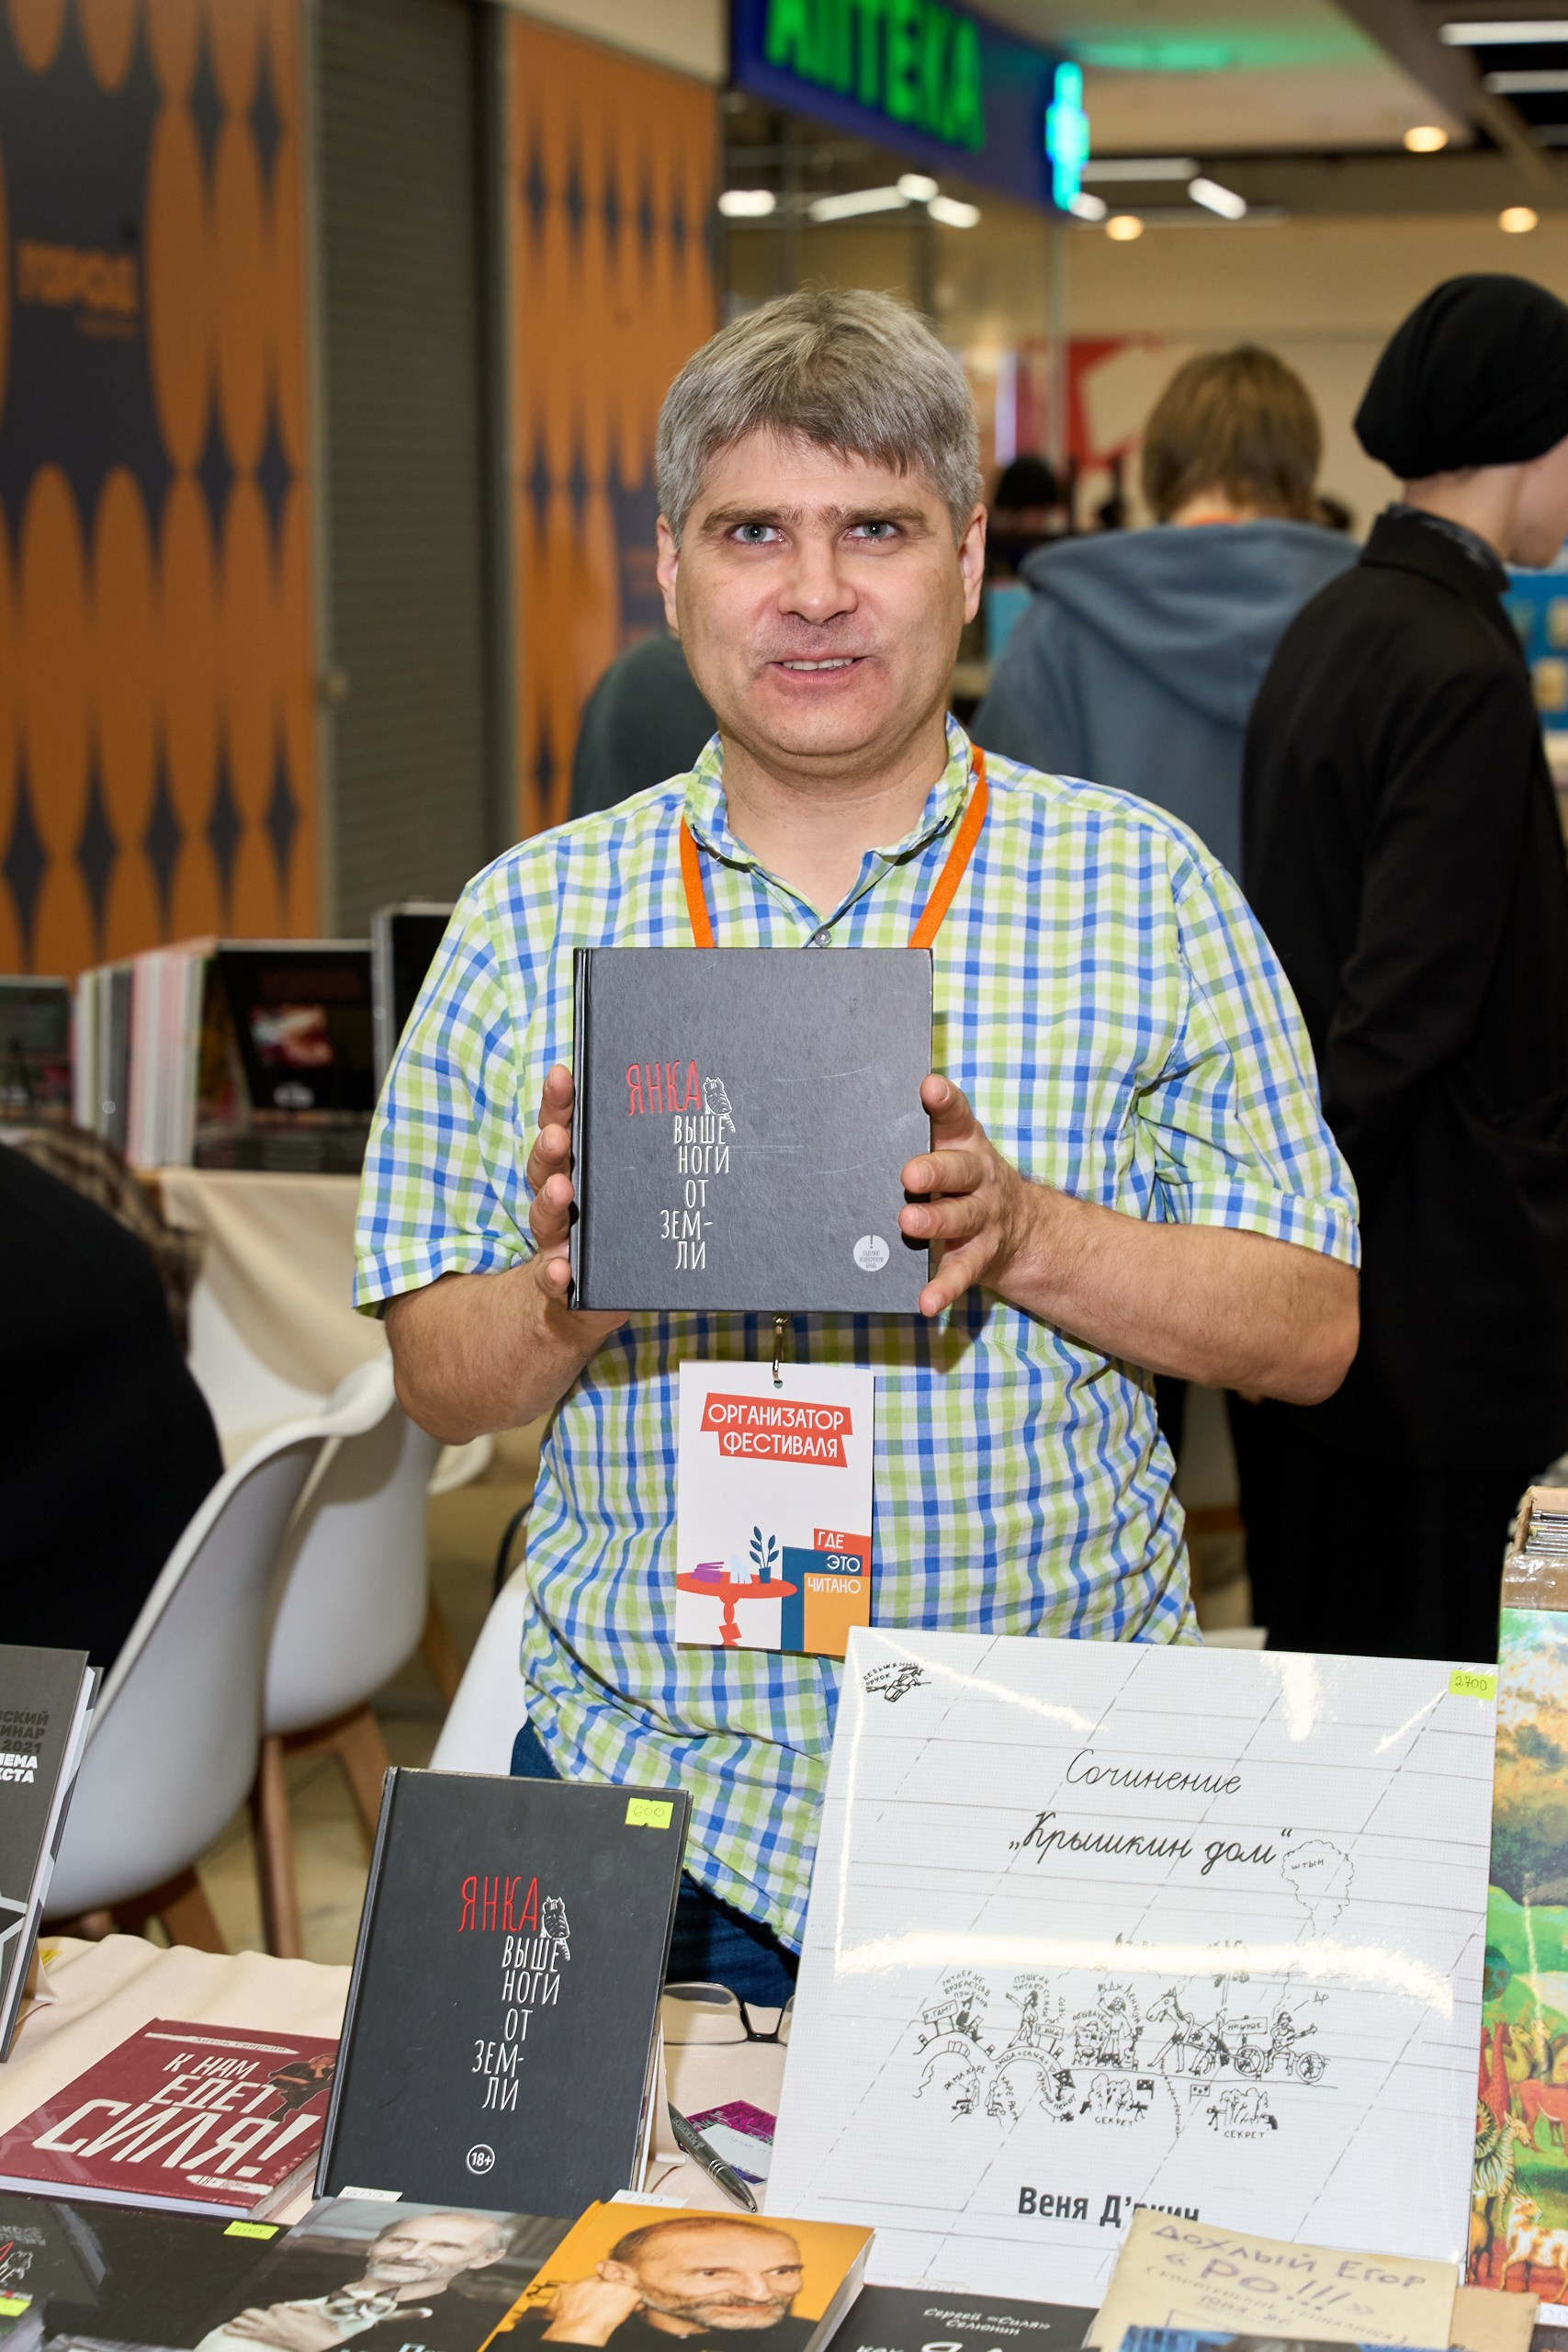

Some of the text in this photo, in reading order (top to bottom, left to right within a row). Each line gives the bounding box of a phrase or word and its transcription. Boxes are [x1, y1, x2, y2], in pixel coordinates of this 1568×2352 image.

[626, 1059, 700, 1115] ЯНКА
[674, 1114, 726, 1144] ВЫШЕ
[678, 1145, 729, 1174] НОГИ
[685, 1180, 709, 1208] ОТ
[660, 1210, 713, 1240] ЗЕМ-
[675, 1241, 706, 1270] ЛИ
[708, 1403, 844, 1430] ОРГАНИЗАТОР
[724, 1431, 838, 1458] ФЕСТИВАЛЯ
[818, 1531, 845, 1549] ГДЕ
[826, 1554, 861, 1572] ЭТО
[807, 1577, 862, 1594] ЧИТАНО
[1454, 1675, 1487, 1691] 2700
[0, 1710, 50, 1725] СКИЙ
[0, 1724, 46, 1739] ИНАР
[1, 1739, 42, 1754] 2021
[1066, 1748, 1242, 1794] Сочинение
[633, 1804, 665, 1818] 600
[459, 1876, 538, 1933] ЯНКА
[502, 1935, 560, 1973] ВЫШЕ
[502, 1969, 561, 2006] НОГИ
[504, 2007, 534, 2041] ОТ
[162, 2052, 262, 2080] К НАМ
[471, 2040, 525, 2078] ЗЕМ-
[147, 2074, 278, 2114] ЕДЕТ
[481, 2076, 520, 2111] ЛИ
[1094, 2116, 1134, 2127] СЕКРЕТ
[1224, 2130, 1265, 2139] СЕКРЕТ
[31, 2098, 322, 2178] СИЛЯ!
[469, 2152, 492, 2167] 18+
[1019, 2186, 1089, 2221] Веня
[923, 2307, 983, 2320] Сергей
[945, 2318, 1021, 2336] Селюнин
